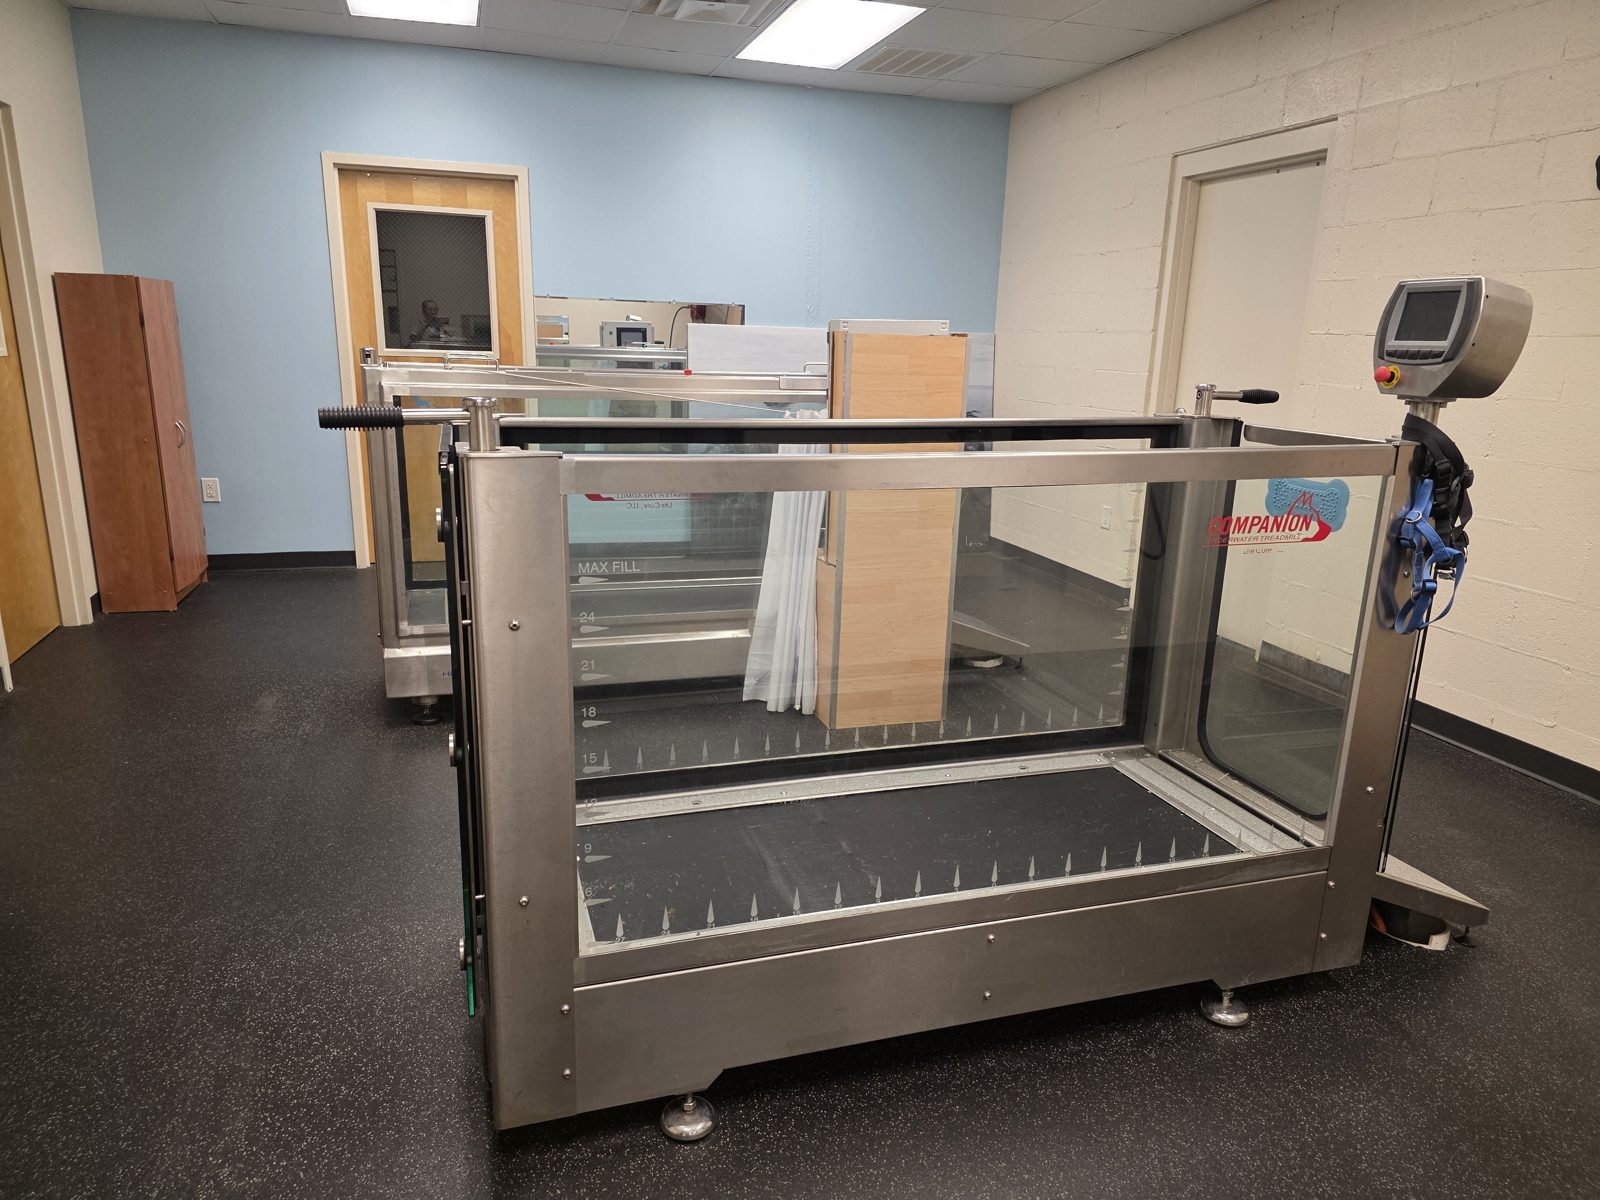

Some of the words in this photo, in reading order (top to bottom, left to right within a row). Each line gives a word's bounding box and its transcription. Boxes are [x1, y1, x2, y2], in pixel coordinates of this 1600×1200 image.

[1208, 513, 1314, 535] COMPANION
[578, 562, 609, 574] MAX
[612, 560, 641, 572] FILL
[579, 611, 596, 623] 24
[580, 660, 596, 671] 21
[581, 706, 597, 718] 18
[582, 752, 598, 764] 15
[583, 798, 598, 809] 12
[584, 843, 592, 854] 9
[585, 887, 593, 897] 6
[585, 929, 593, 939] 3
